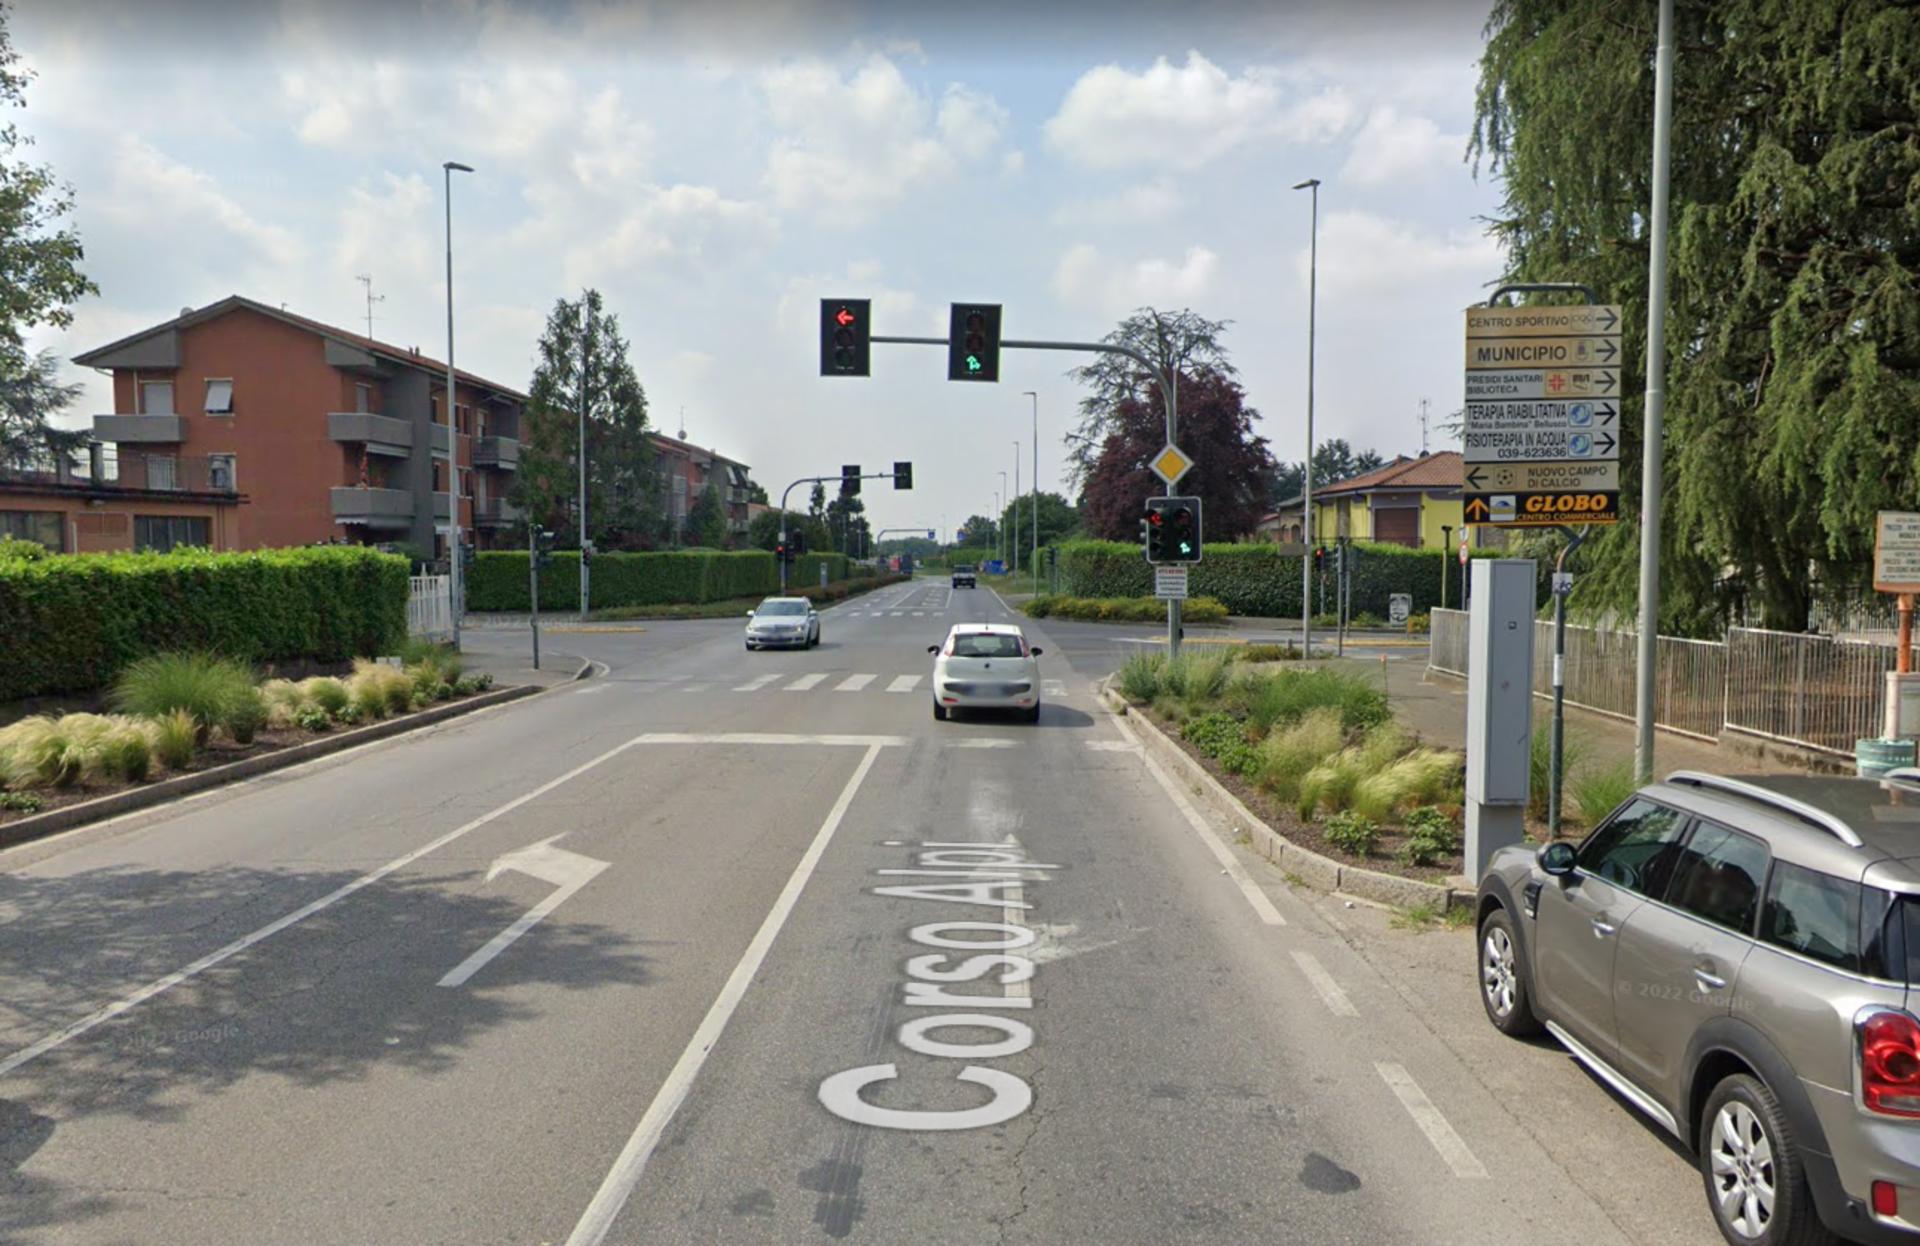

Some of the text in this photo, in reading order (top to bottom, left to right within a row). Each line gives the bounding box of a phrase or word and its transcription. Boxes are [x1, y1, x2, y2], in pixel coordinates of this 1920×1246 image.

[1468, 315, 1569, 328] CENTRO SPORTIVO
[1477, 345, 1567, 361] MUNICIPIO
[1467, 374, 1543, 383] PRESIDI SANITARI
[1467, 385, 1519, 394] BIBLIOTECA
[1467, 403, 1566, 420] TERAPIA RIABILITATIVA
[1466, 432, 1567, 448] FISIOTERAPIA IN ACQUA
[1497, 448, 1567, 459] 039-623636
[1527, 466, 1608, 477] NUOVO CAMPO
[1527, 478, 1581, 488] DI CALCIO
[1525, 494, 1608, 512] GLOBO
[1516, 512, 1616, 521] CENTRO COMMERCIALE
